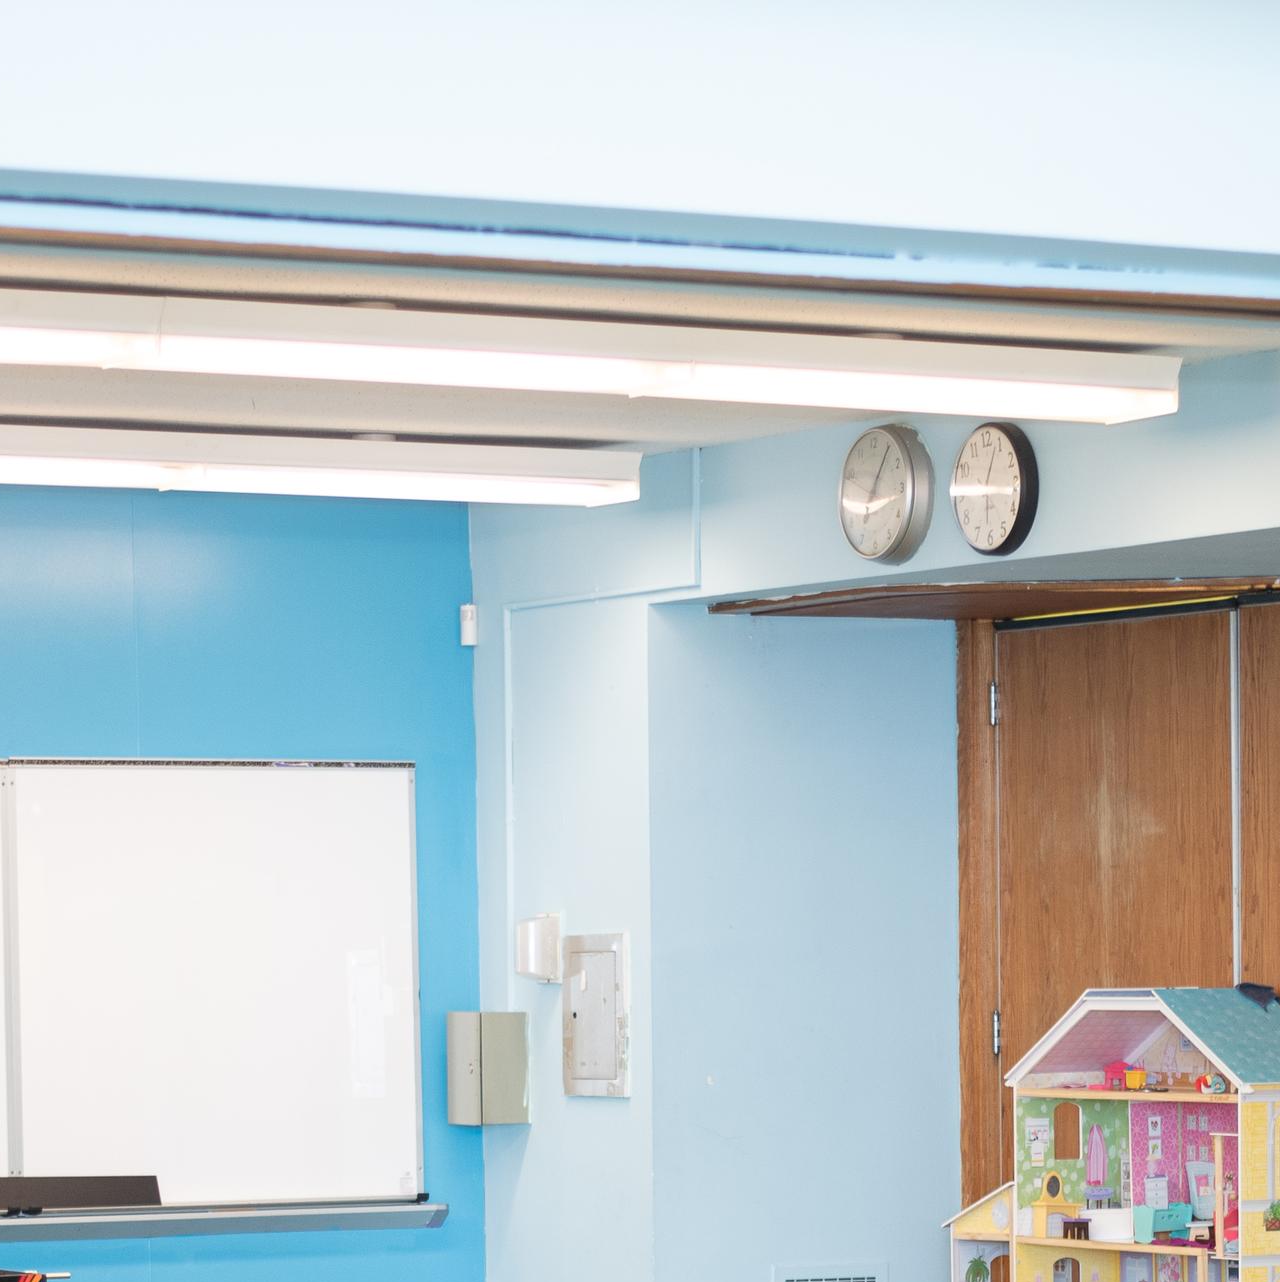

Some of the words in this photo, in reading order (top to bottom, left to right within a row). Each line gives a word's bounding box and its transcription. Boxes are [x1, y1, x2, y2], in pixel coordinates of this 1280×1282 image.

[870, 437, 878, 449] 12
[981, 430, 992, 448] 12
[998, 436, 1002, 452] 1
[970, 442, 978, 458] 11
[895, 457, 900, 469] 2
[1008, 452, 1014, 468] 2
[960, 462, 970, 478] 10
[1010, 500, 1016, 516] 4
[963, 509, 970, 525] 8
[974, 526, 980, 543] 7
[987, 529, 994, 546] 6
[1000, 521, 1006, 538] 5
